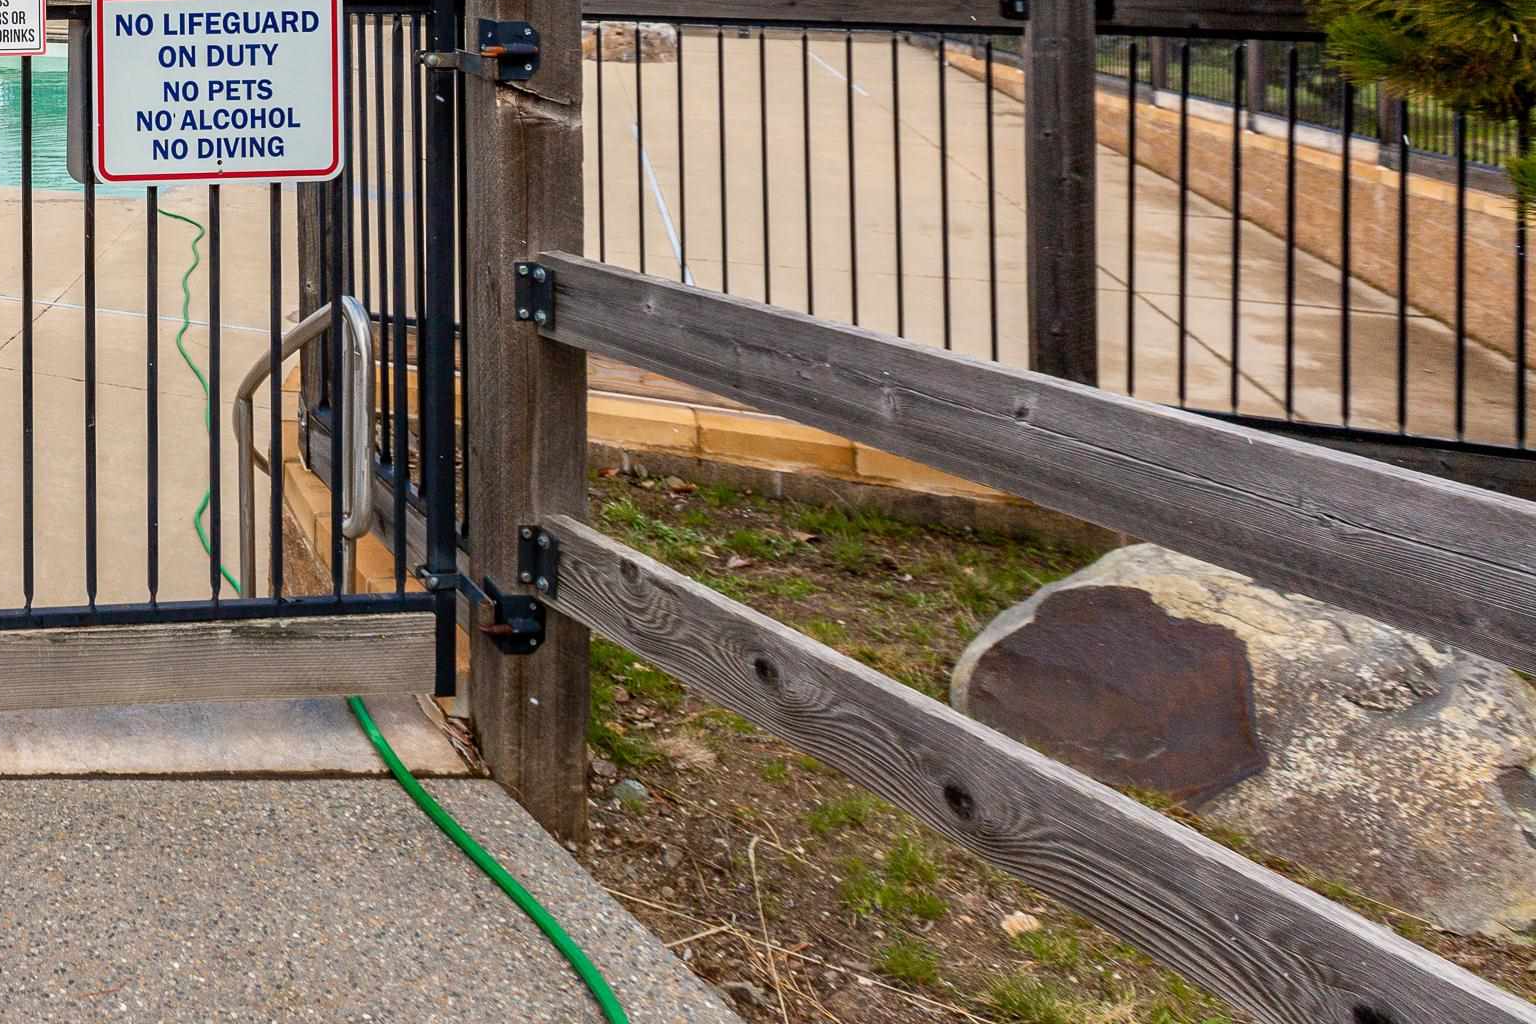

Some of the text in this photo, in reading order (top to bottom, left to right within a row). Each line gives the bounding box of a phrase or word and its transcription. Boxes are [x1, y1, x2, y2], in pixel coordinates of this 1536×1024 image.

[12, 11, 26, 24] OR
[116, 11, 320, 36] NO LIFEGUARD
[158, 44, 278, 68] ON DUTY
[164, 79, 273, 102] NO PETS
[137, 107, 301, 132] NO ALCOHOL
[153, 136, 285, 160] NO DIVING
